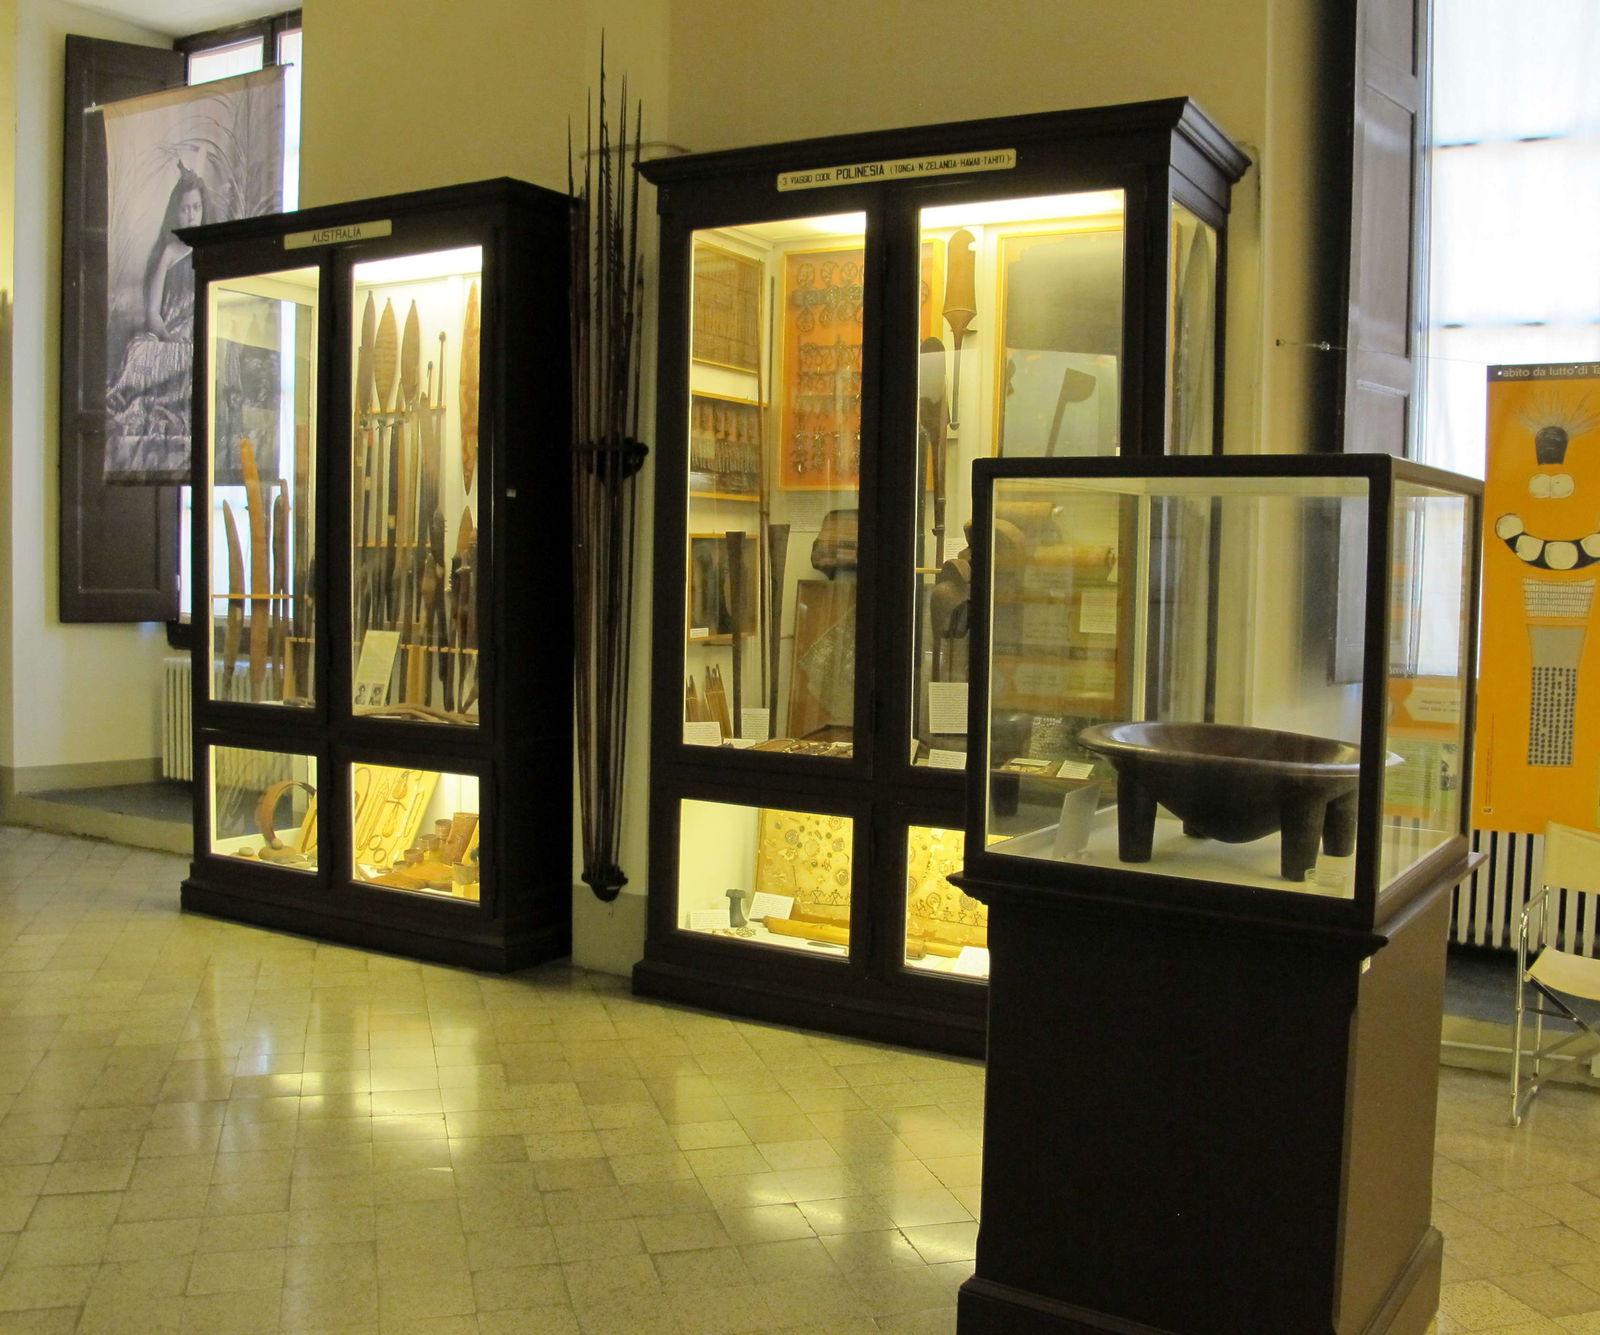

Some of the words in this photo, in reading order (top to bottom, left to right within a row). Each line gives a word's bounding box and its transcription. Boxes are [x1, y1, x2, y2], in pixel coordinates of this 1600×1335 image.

[836, 164, 885, 180] POLINESIA
[312, 227, 361, 243] AUSTRALIA
[1503, 366, 1530, 378] abito
[1533, 366, 1546, 377] da
[1549, 366, 1575, 377] lutto
[1577, 365, 1588, 376] di
